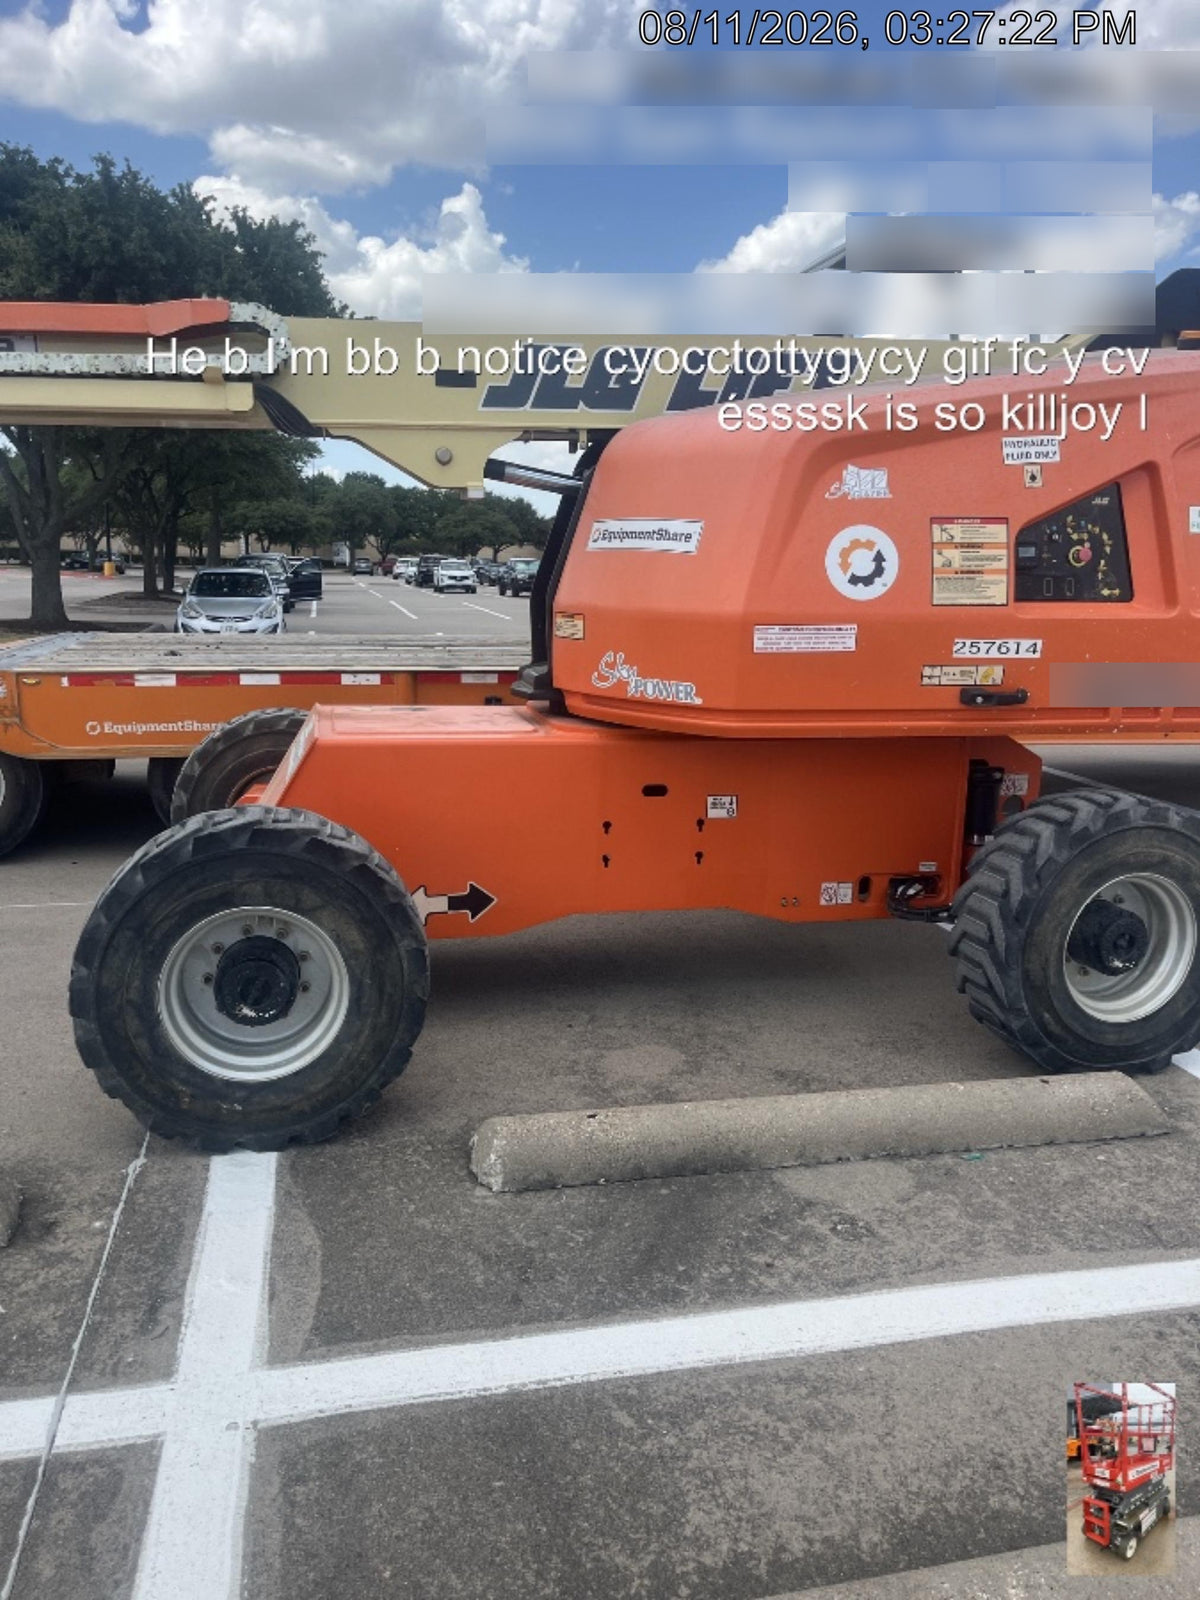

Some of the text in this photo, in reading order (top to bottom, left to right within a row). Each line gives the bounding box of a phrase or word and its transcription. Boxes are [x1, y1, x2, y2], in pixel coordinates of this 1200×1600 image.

[478, 342, 658, 413] JLG
[600, 527, 693, 543] EquipmentShare
[953, 641, 1039, 655] 257614
